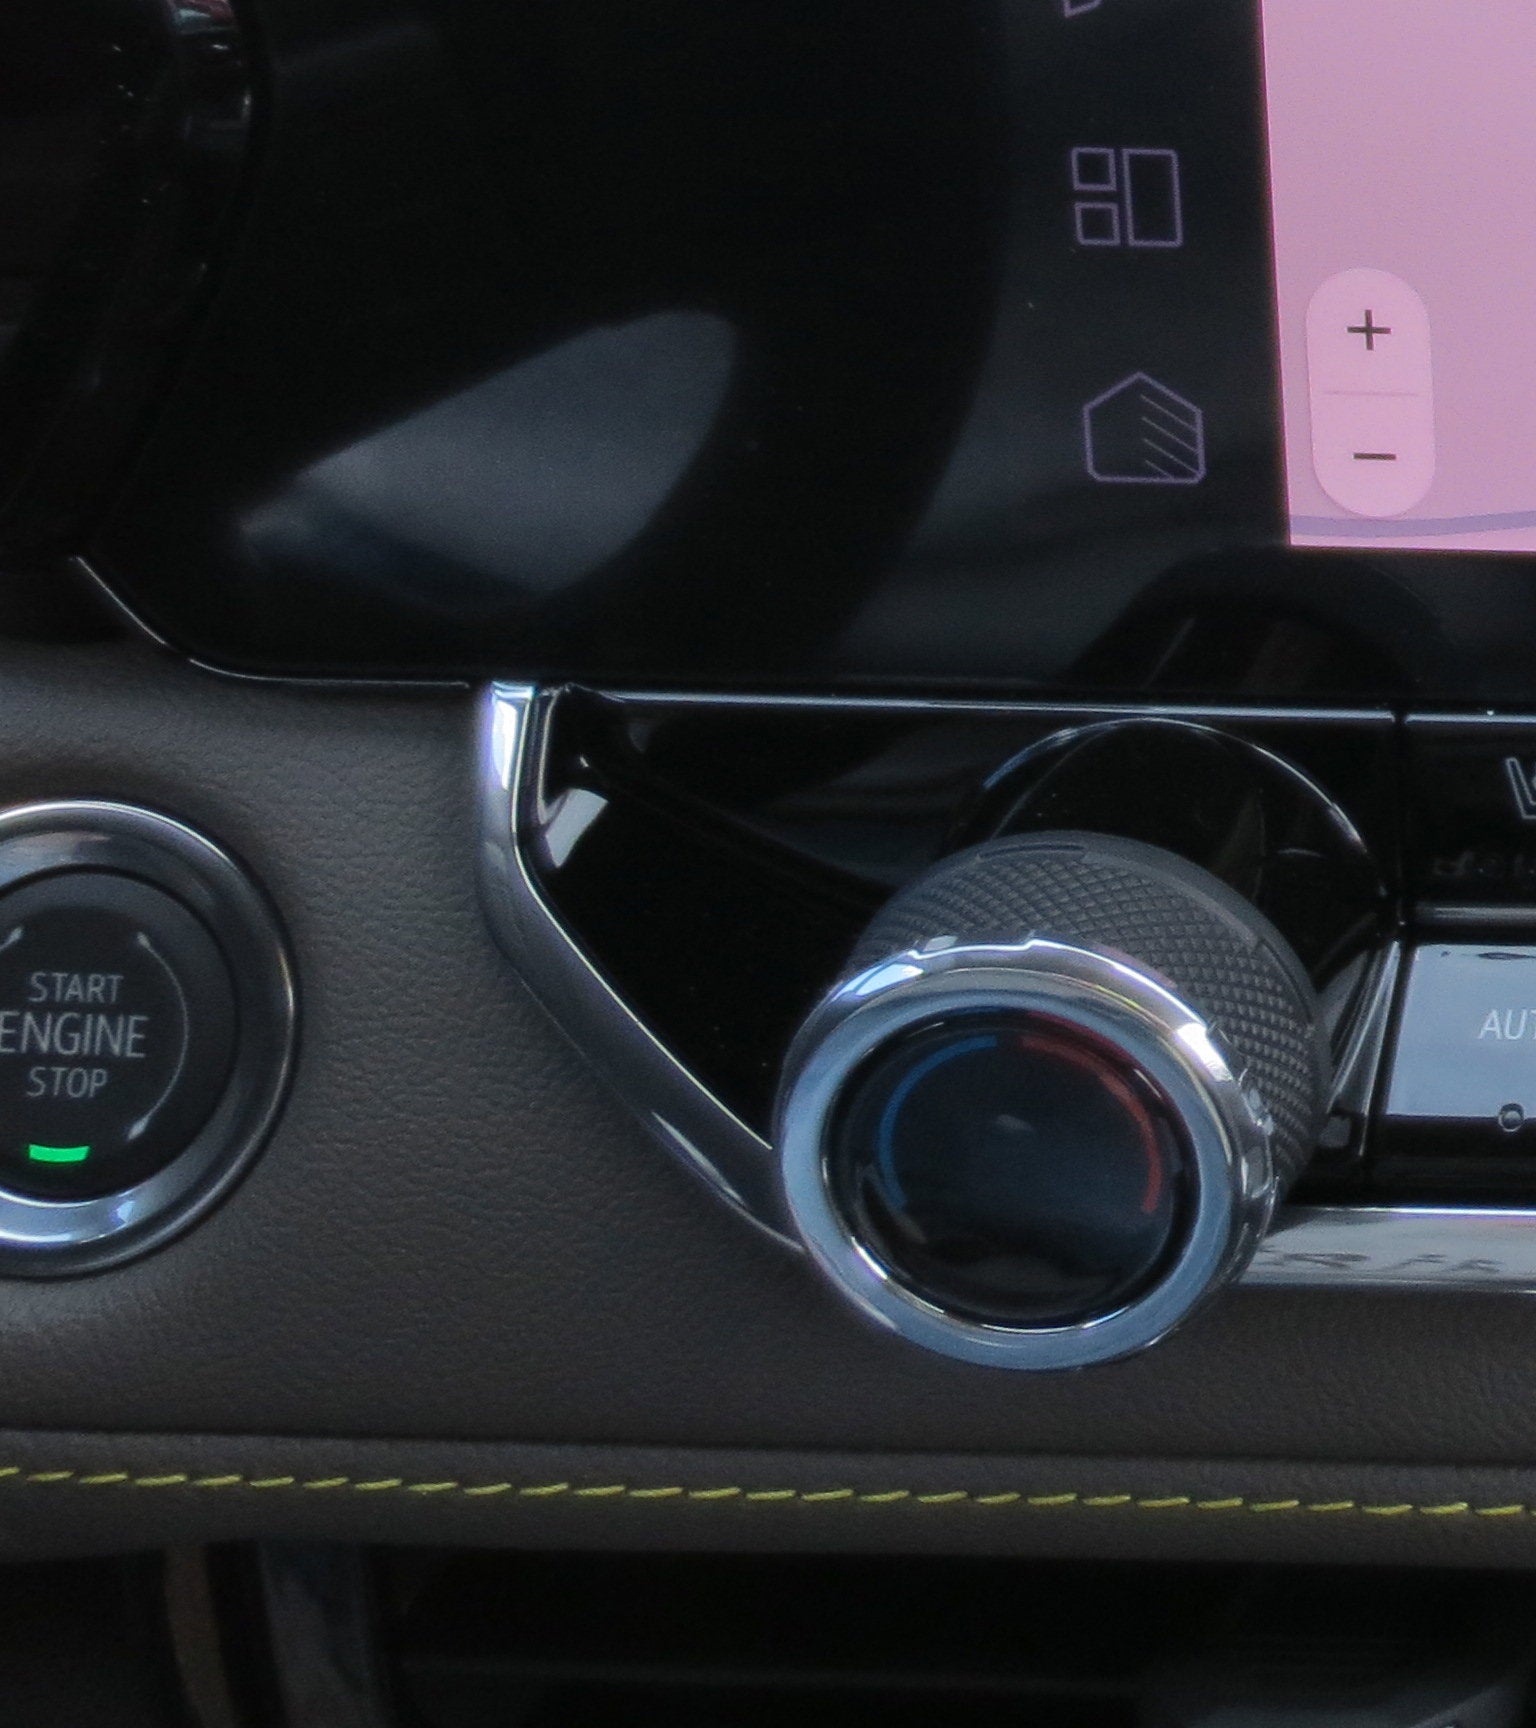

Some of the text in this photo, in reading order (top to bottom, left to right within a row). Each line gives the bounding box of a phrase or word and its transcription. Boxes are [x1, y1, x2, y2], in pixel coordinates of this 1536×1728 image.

[27, 971, 125, 1005] START
[0, 1011, 150, 1059] ENGINE
[26, 1066, 109, 1099] STOP
